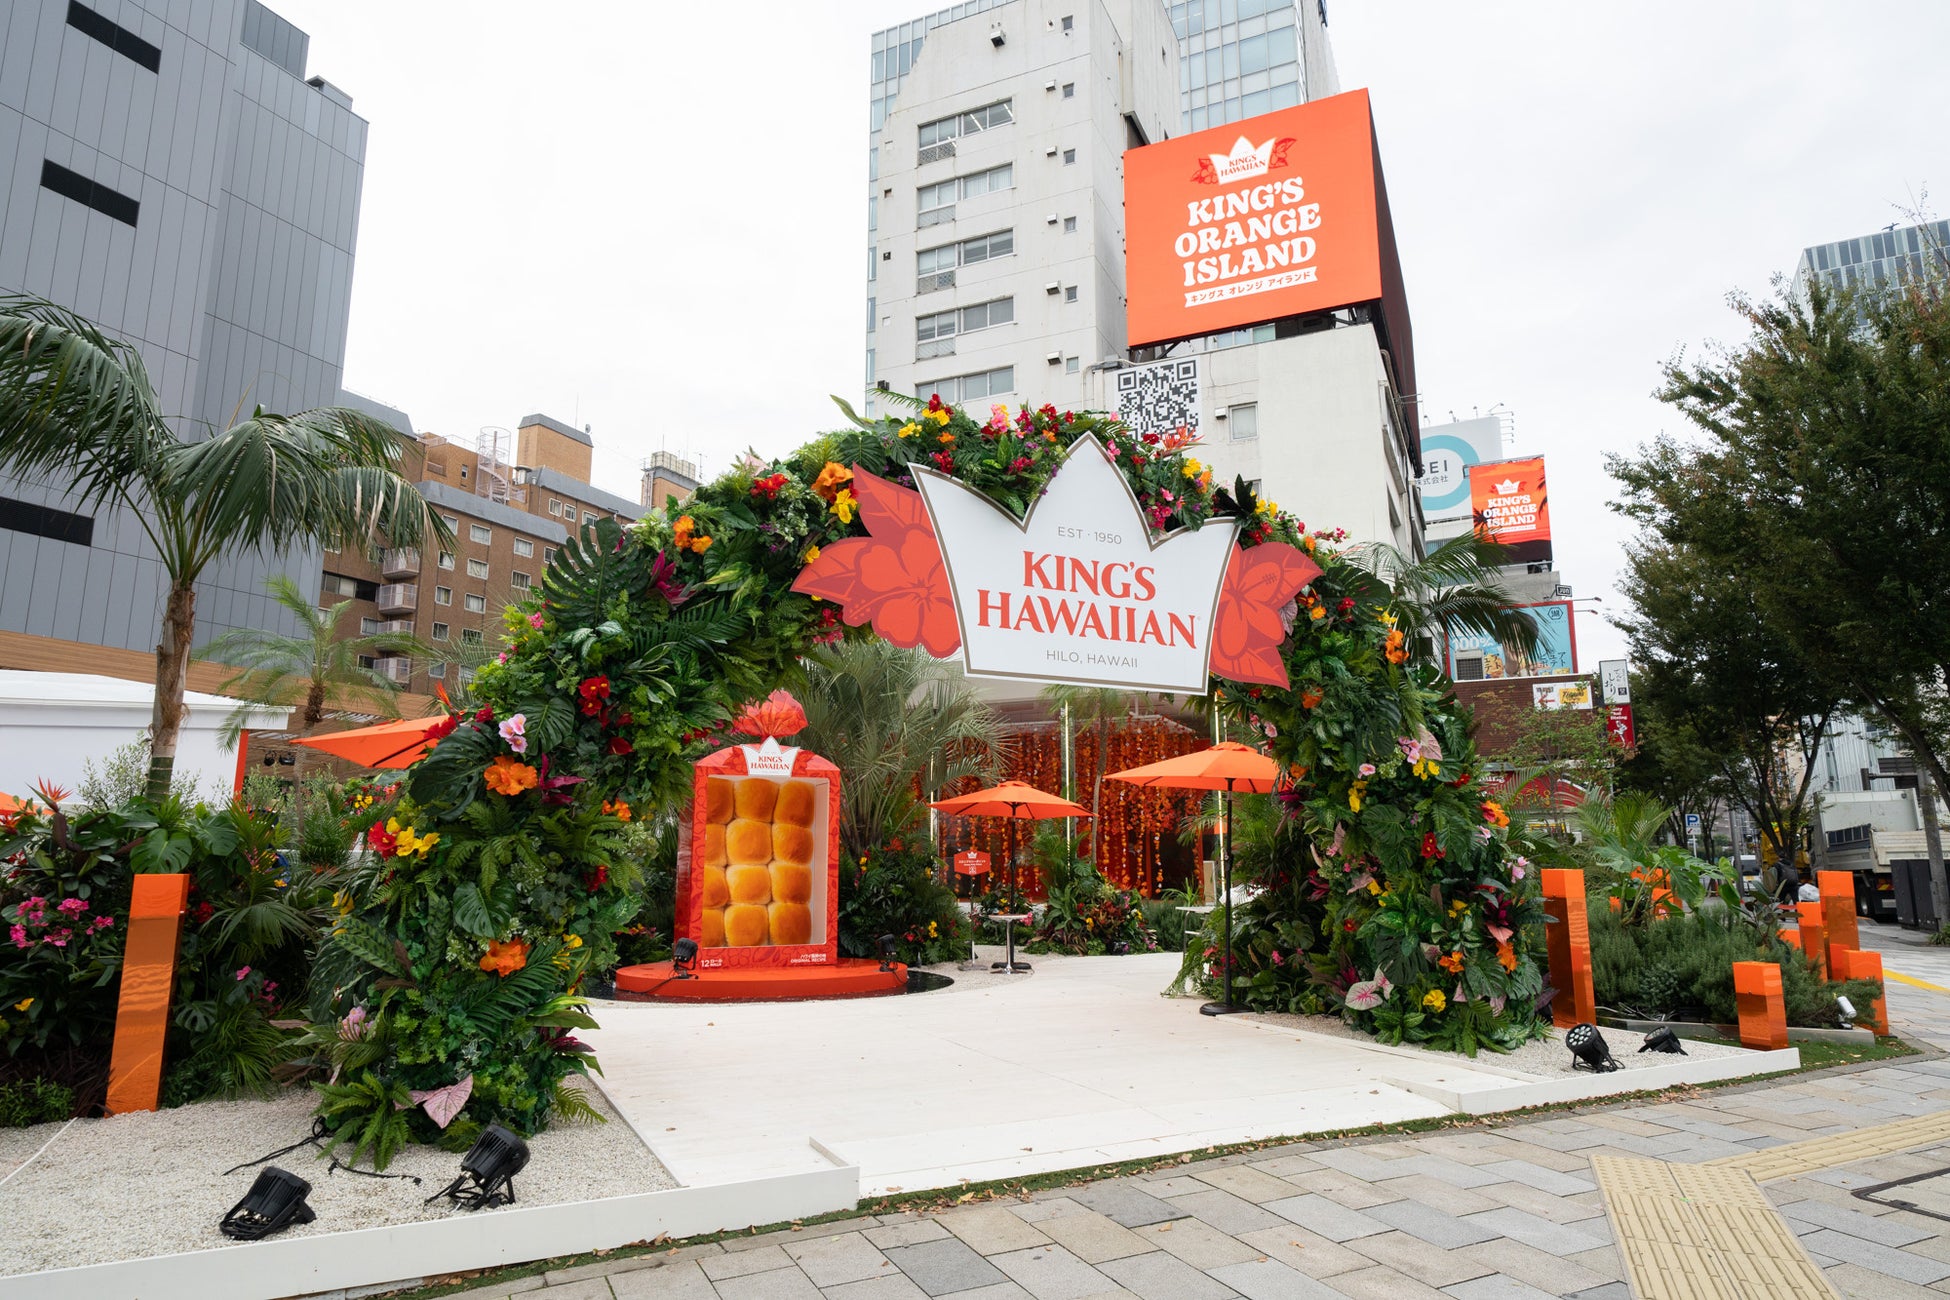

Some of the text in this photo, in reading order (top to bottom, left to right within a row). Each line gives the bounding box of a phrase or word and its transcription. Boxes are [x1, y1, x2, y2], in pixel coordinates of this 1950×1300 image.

[1220, 160, 1266, 176] HAWAIIAN
[1187, 176, 1305, 227] KING'S
[1174, 202, 1322, 258] ORANGE
[1182, 236, 1317, 287] ISLAND
[1191, 271, 1310, 303] キングス オレンジ アイランド
[1483, 503, 1537, 518] ORANGE
[1487, 494, 1531, 508] KING'S
[1487, 514, 1536, 528] ISLAND
[1057, 526, 1122, 545] EST 1950
[1023, 550, 1156, 601] KING'S
[977, 589, 1197, 649] HAWAIIAN
[1046, 649, 1138, 668] HILO, HAWAII
[750, 762, 790, 770] HAWAIIAN
[701, 959, 709, 967] 12
